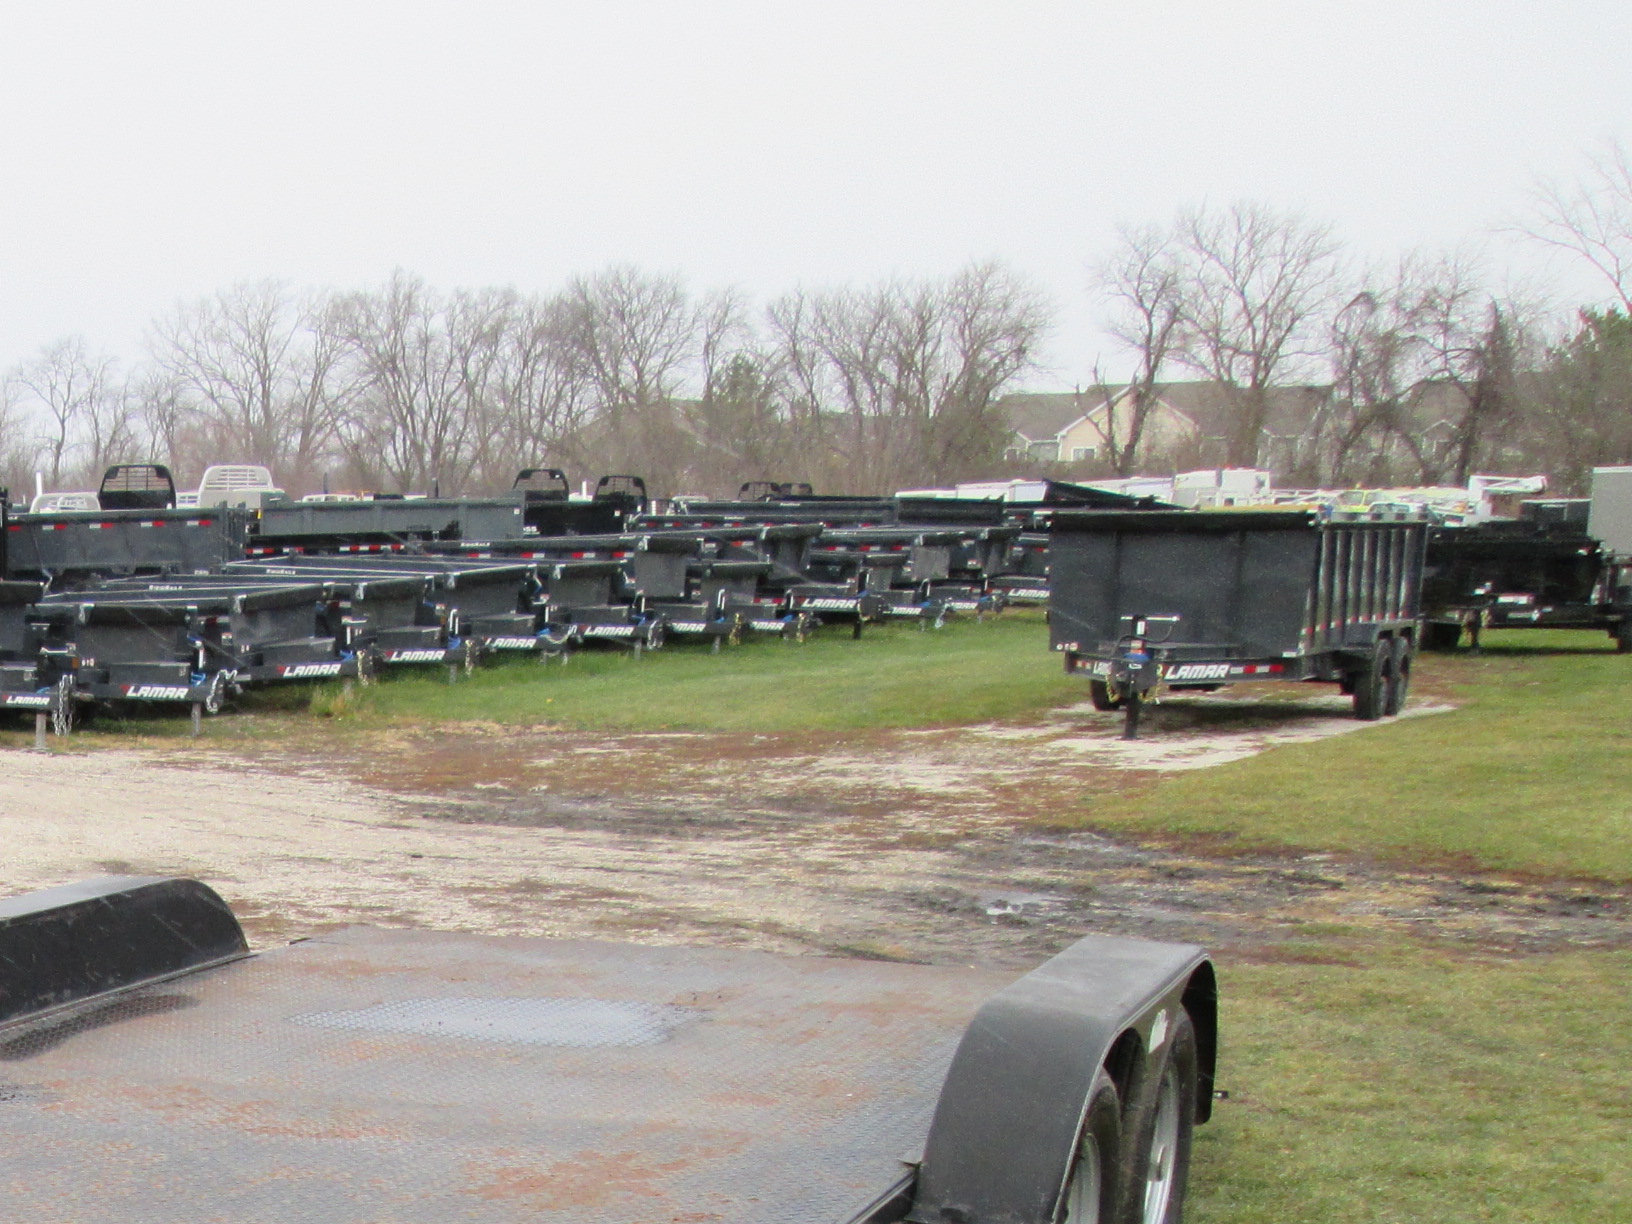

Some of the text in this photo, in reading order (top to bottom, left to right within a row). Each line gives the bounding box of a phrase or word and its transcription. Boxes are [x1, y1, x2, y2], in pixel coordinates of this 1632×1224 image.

[801, 598, 857, 609] LAMAR
[584, 626, 634, 636] LAMAR
[391, 650, 446, 661] LAMAR
[283, 663, 341, 677] LAMAR
[1165, 664, 1230, 679] LAMAR
[126, 685, 189, 699] LAMAR
[6, 695, 50, 705] LAMAR
